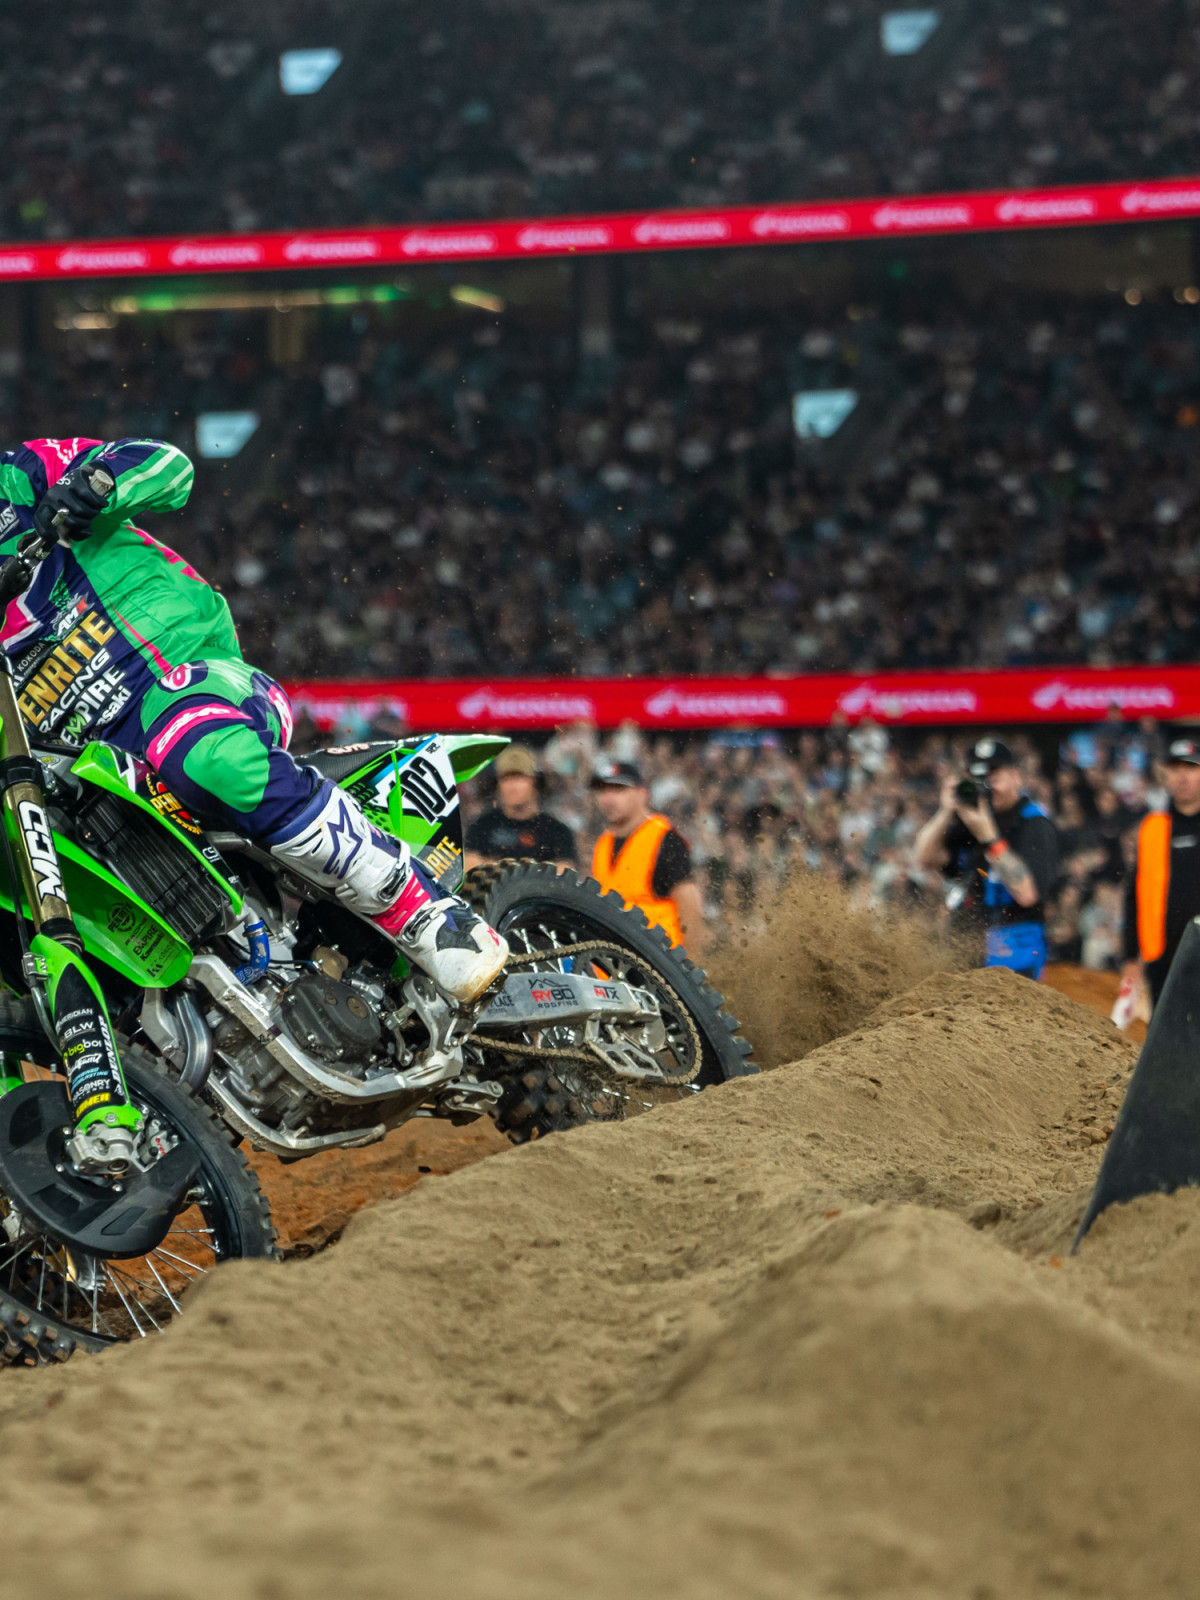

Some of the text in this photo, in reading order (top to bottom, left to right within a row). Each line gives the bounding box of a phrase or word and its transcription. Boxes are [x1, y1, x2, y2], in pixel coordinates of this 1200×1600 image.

[56, 597, 90, 637] AMX
[17, 642, 45, 672] KOKODA
[17, 611, 115, 727] ENRITE
[38, 647, 111, 734] RACING
[60, 664, 126, 746] EMPIRE
[390, 756, 457, 824] 102
[63, 1022, 93, 1038] BLW
[98, 1015, 122, 1084] DUNLOP
